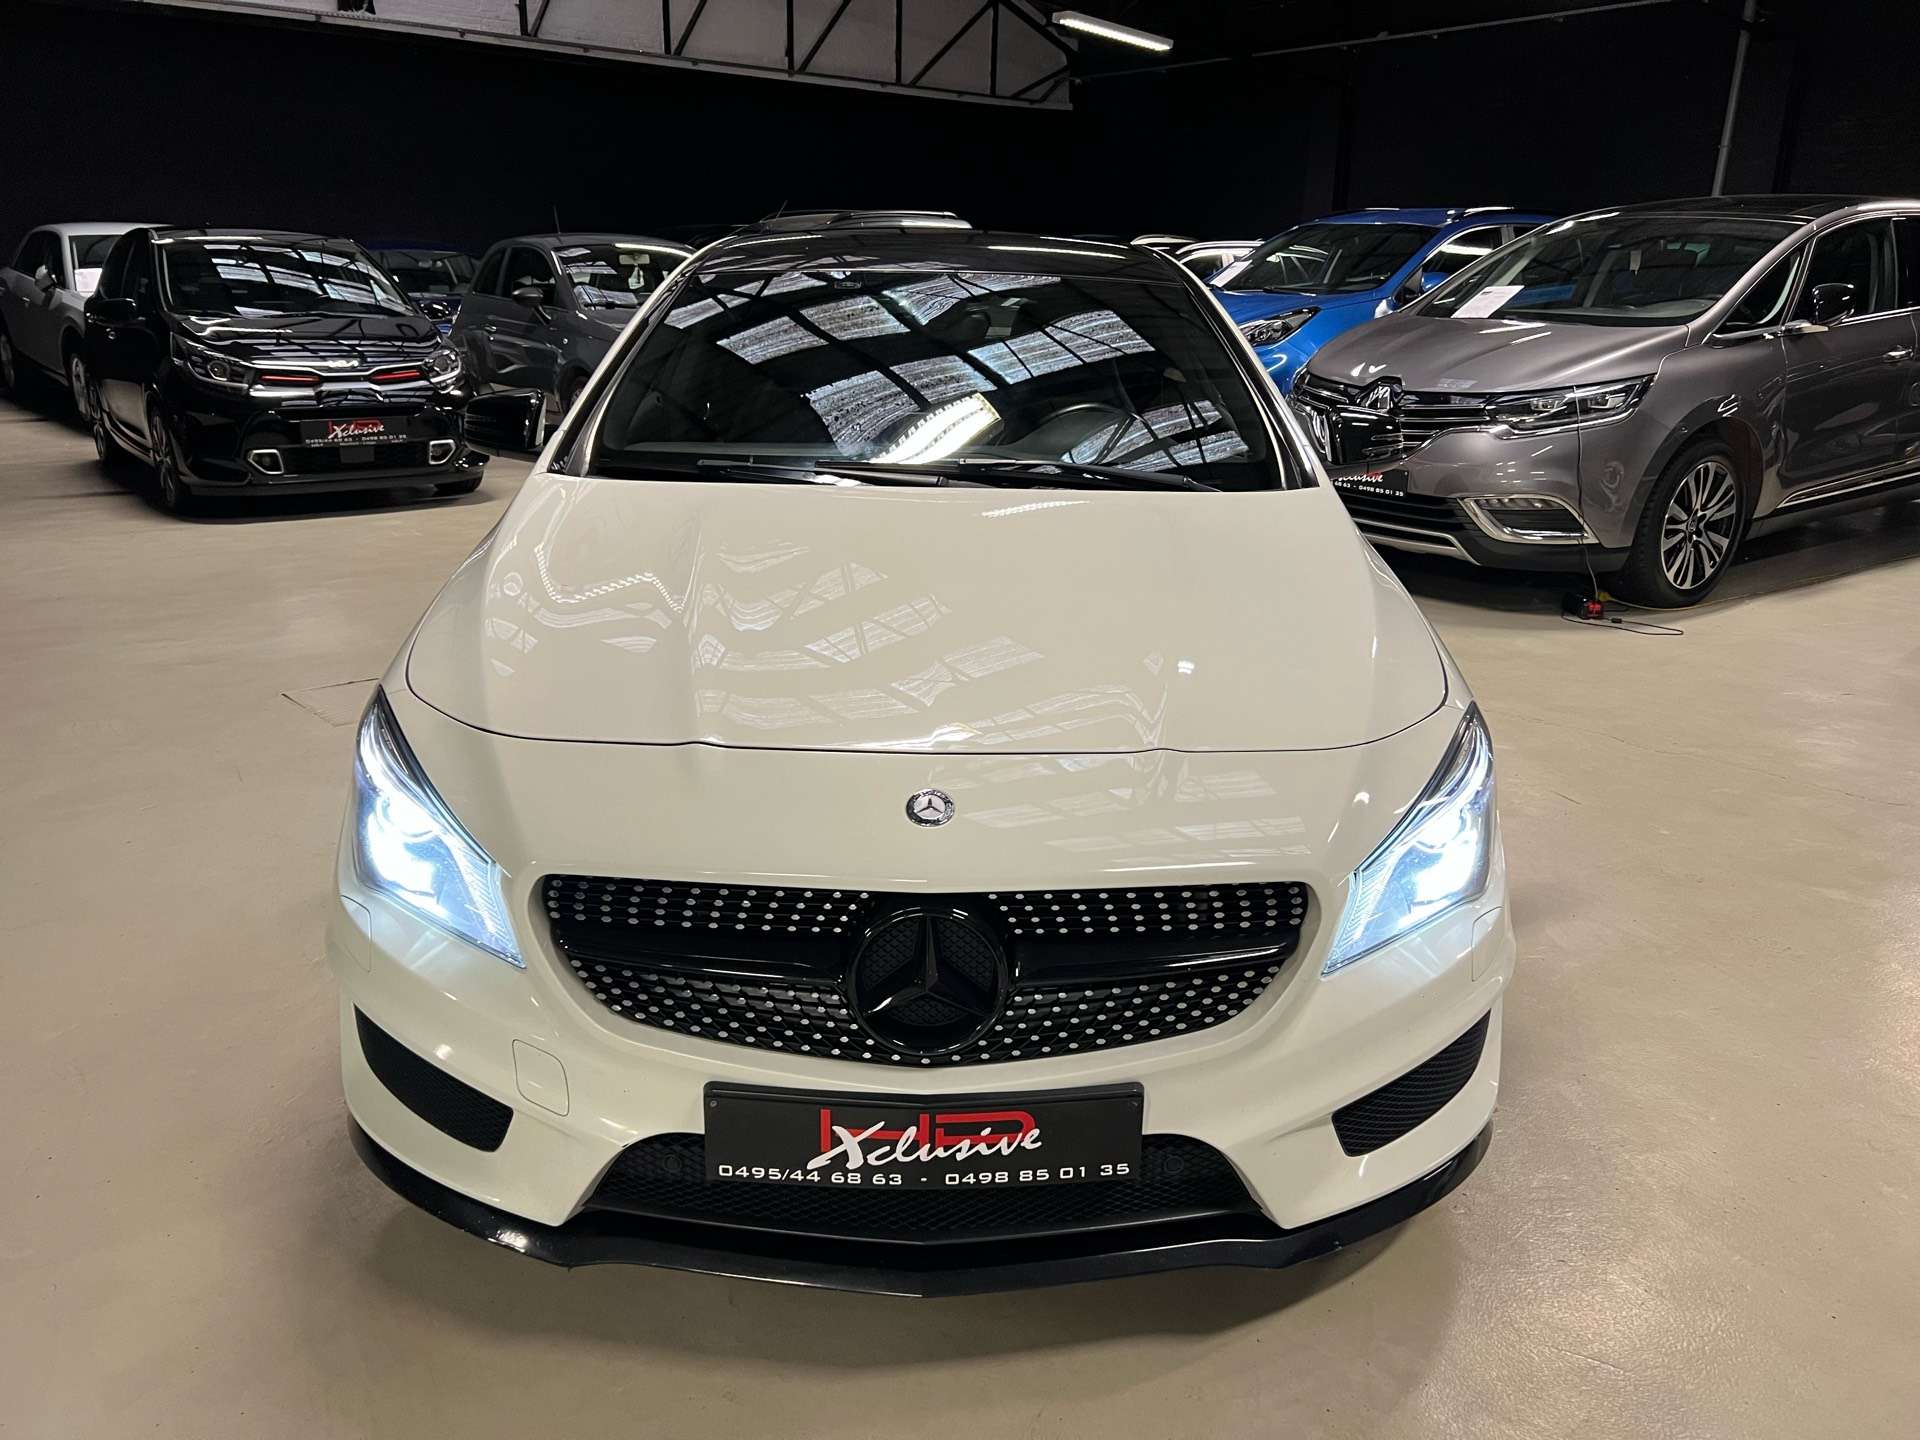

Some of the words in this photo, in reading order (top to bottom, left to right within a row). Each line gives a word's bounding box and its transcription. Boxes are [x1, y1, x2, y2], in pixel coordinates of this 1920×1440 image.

[327, 423, 385, 439] Xclusive
[806, 1121, 1042, 1170] Xclusive
[718, 1164, 821, 1182] 0495/44
[831, 1172, 862, 1184] 68
[872, 1173, 902, 1185] 63
[945, 1171, 1009, 1185] 0498
[1019, 1168, 1050, 1182] 85
[1059, 1166, 1086, 1179] 01
[1100, 1163, 1130, 1176] 35
